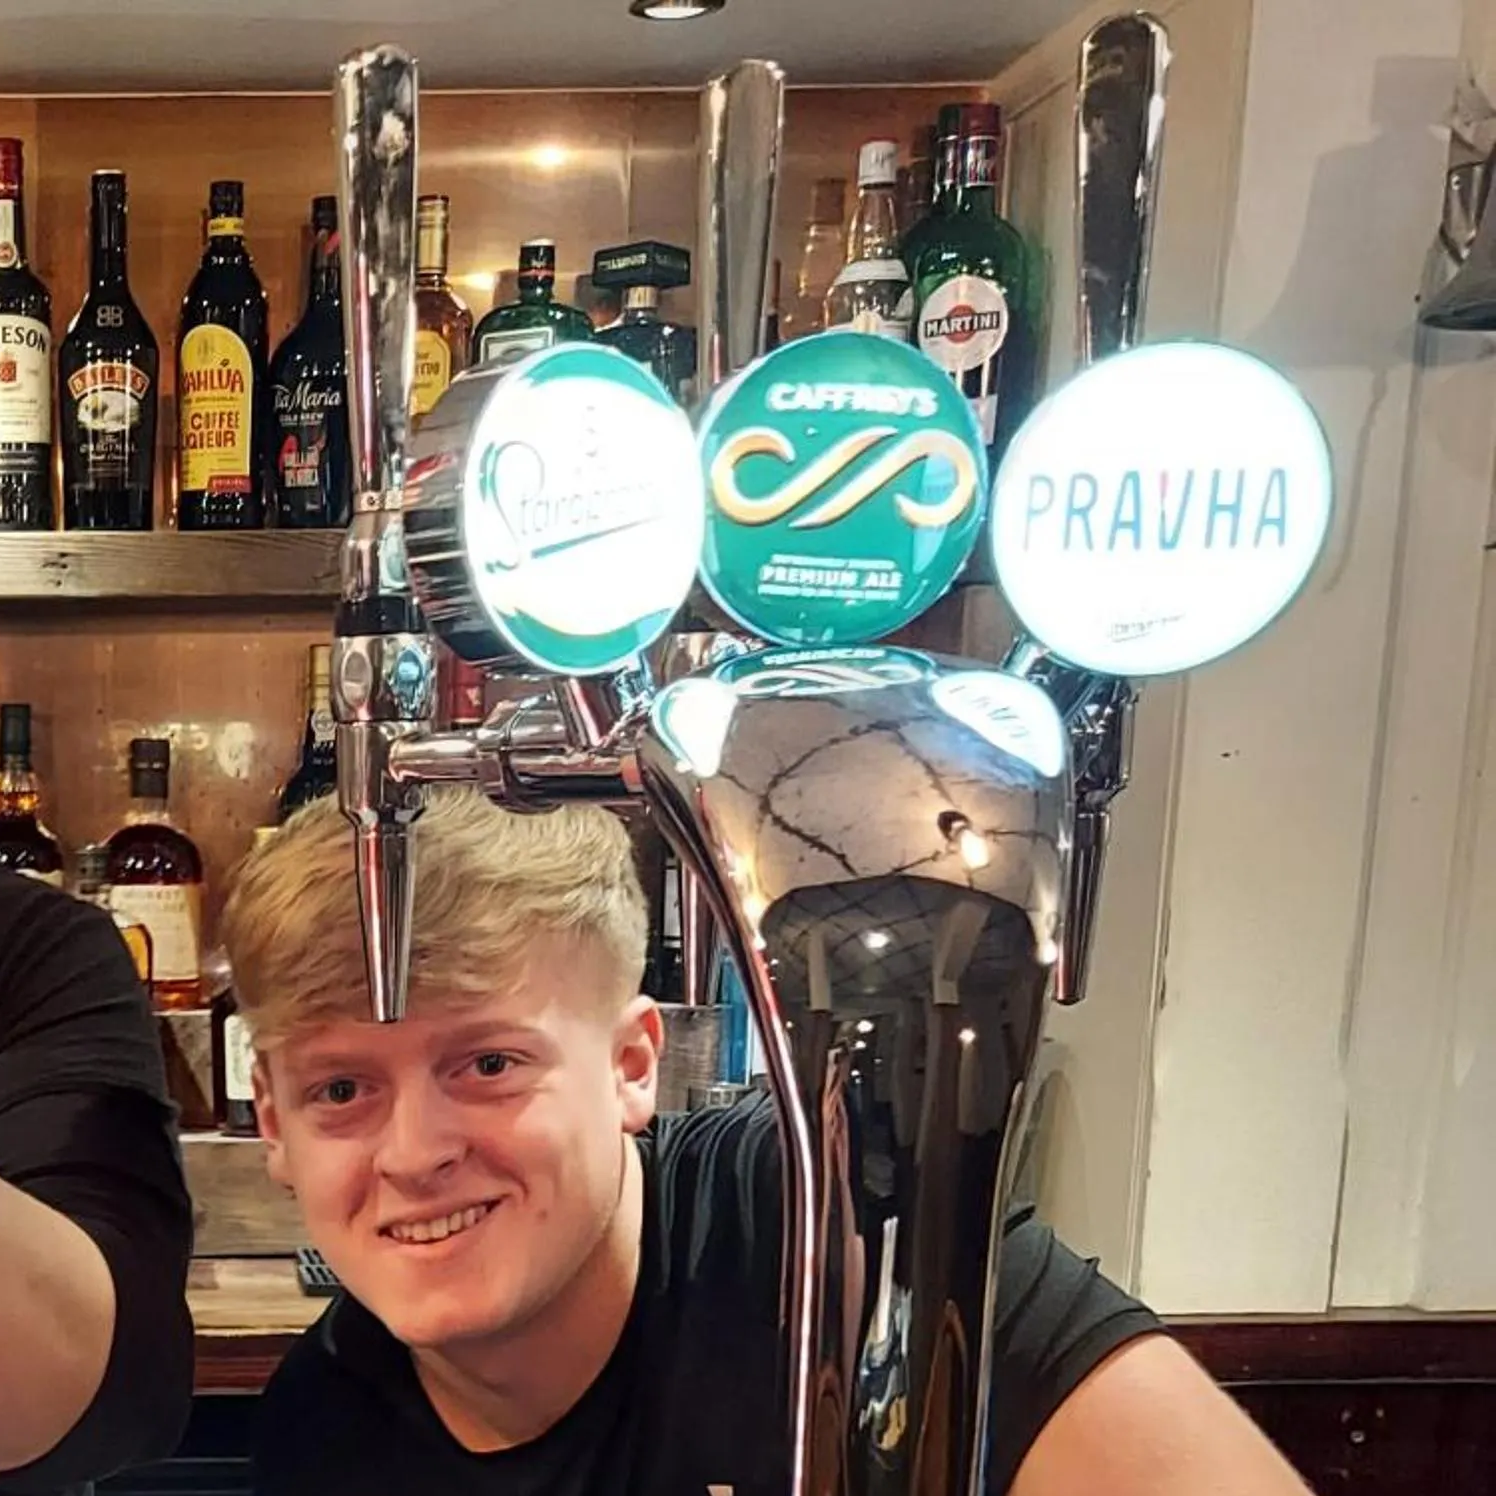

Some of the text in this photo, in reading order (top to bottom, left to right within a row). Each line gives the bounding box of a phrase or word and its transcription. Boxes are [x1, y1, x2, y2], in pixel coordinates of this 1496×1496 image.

[925, 312, 999, 339] MARTINI
[288, 381, 342, 410] Maria
[1022, 467, 1287, 552] PRAVHA
[760, 564, 902, 588] PREMIUM ALE
